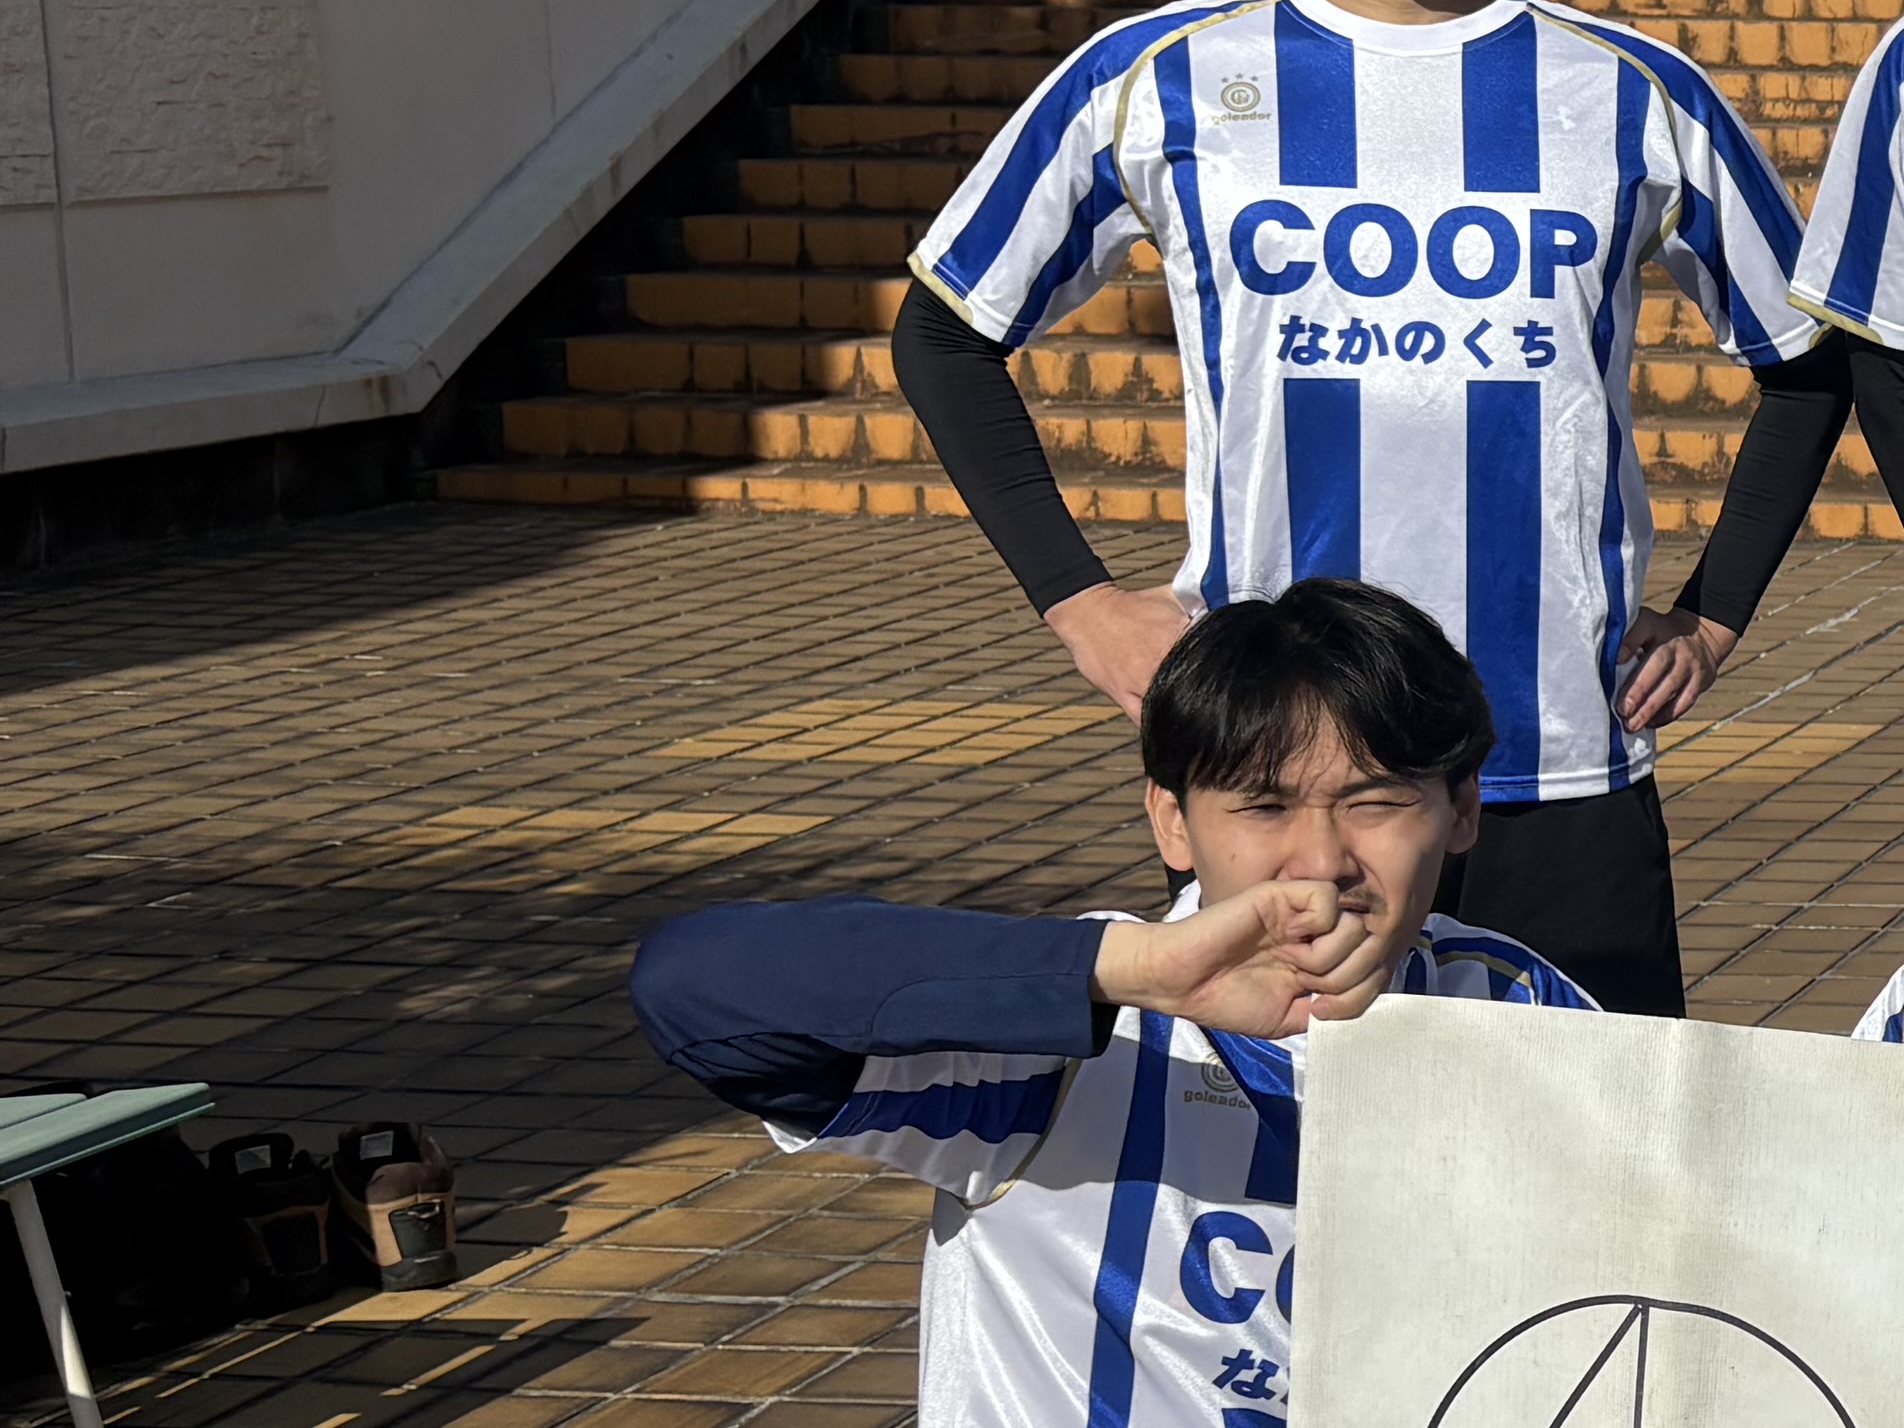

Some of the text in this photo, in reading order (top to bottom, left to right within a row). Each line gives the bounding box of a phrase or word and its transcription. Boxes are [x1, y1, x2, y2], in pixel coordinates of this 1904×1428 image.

[1231, 199, 1598, 300] COOP
[1277, 315, 1557, 369] なかのくち
[1179, 1210, 1293, 1324] C
[1213, 1348, 1288, 1406] な
